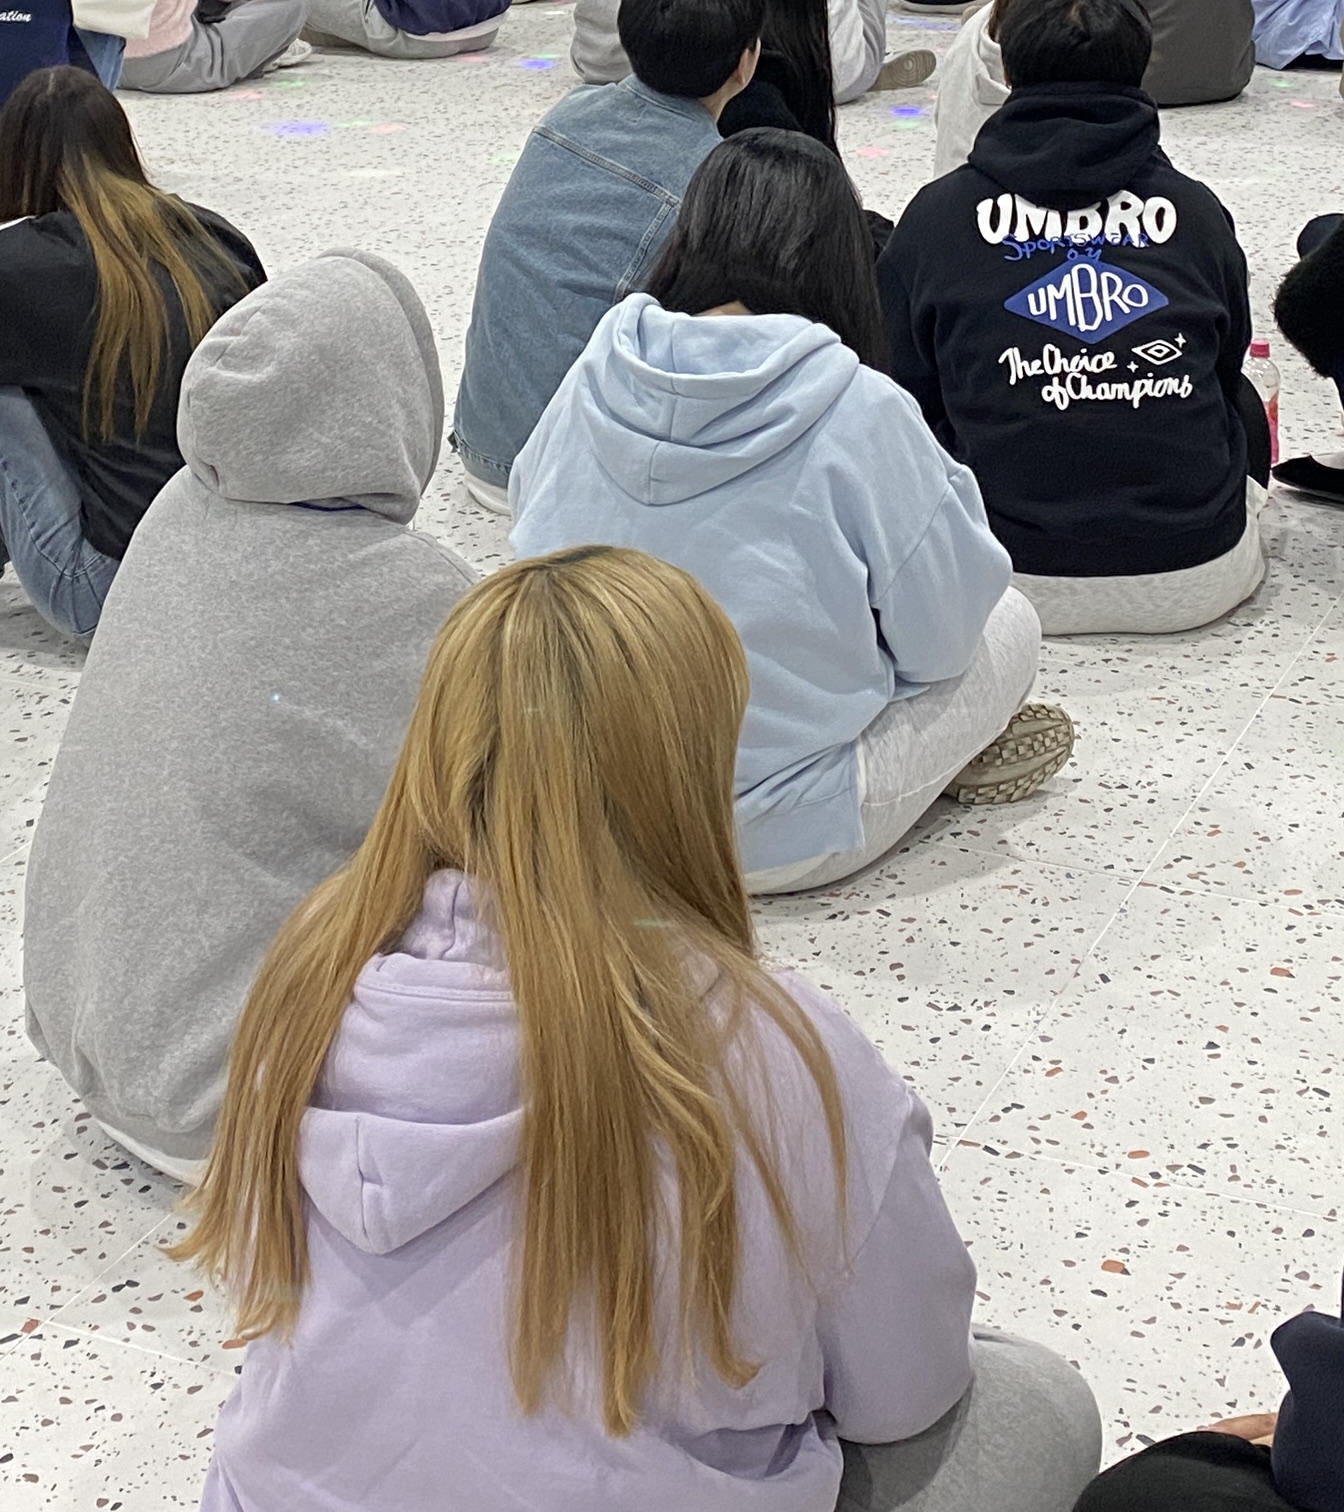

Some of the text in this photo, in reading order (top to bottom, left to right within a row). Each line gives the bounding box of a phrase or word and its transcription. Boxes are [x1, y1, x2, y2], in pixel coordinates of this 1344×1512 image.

[976, 189, 1178, 249] UMBRO
[1027, 263, 1149, 331] UMBRO
[998, 346, 1045, 385] The
[1041, 376, 1070, 410] of
